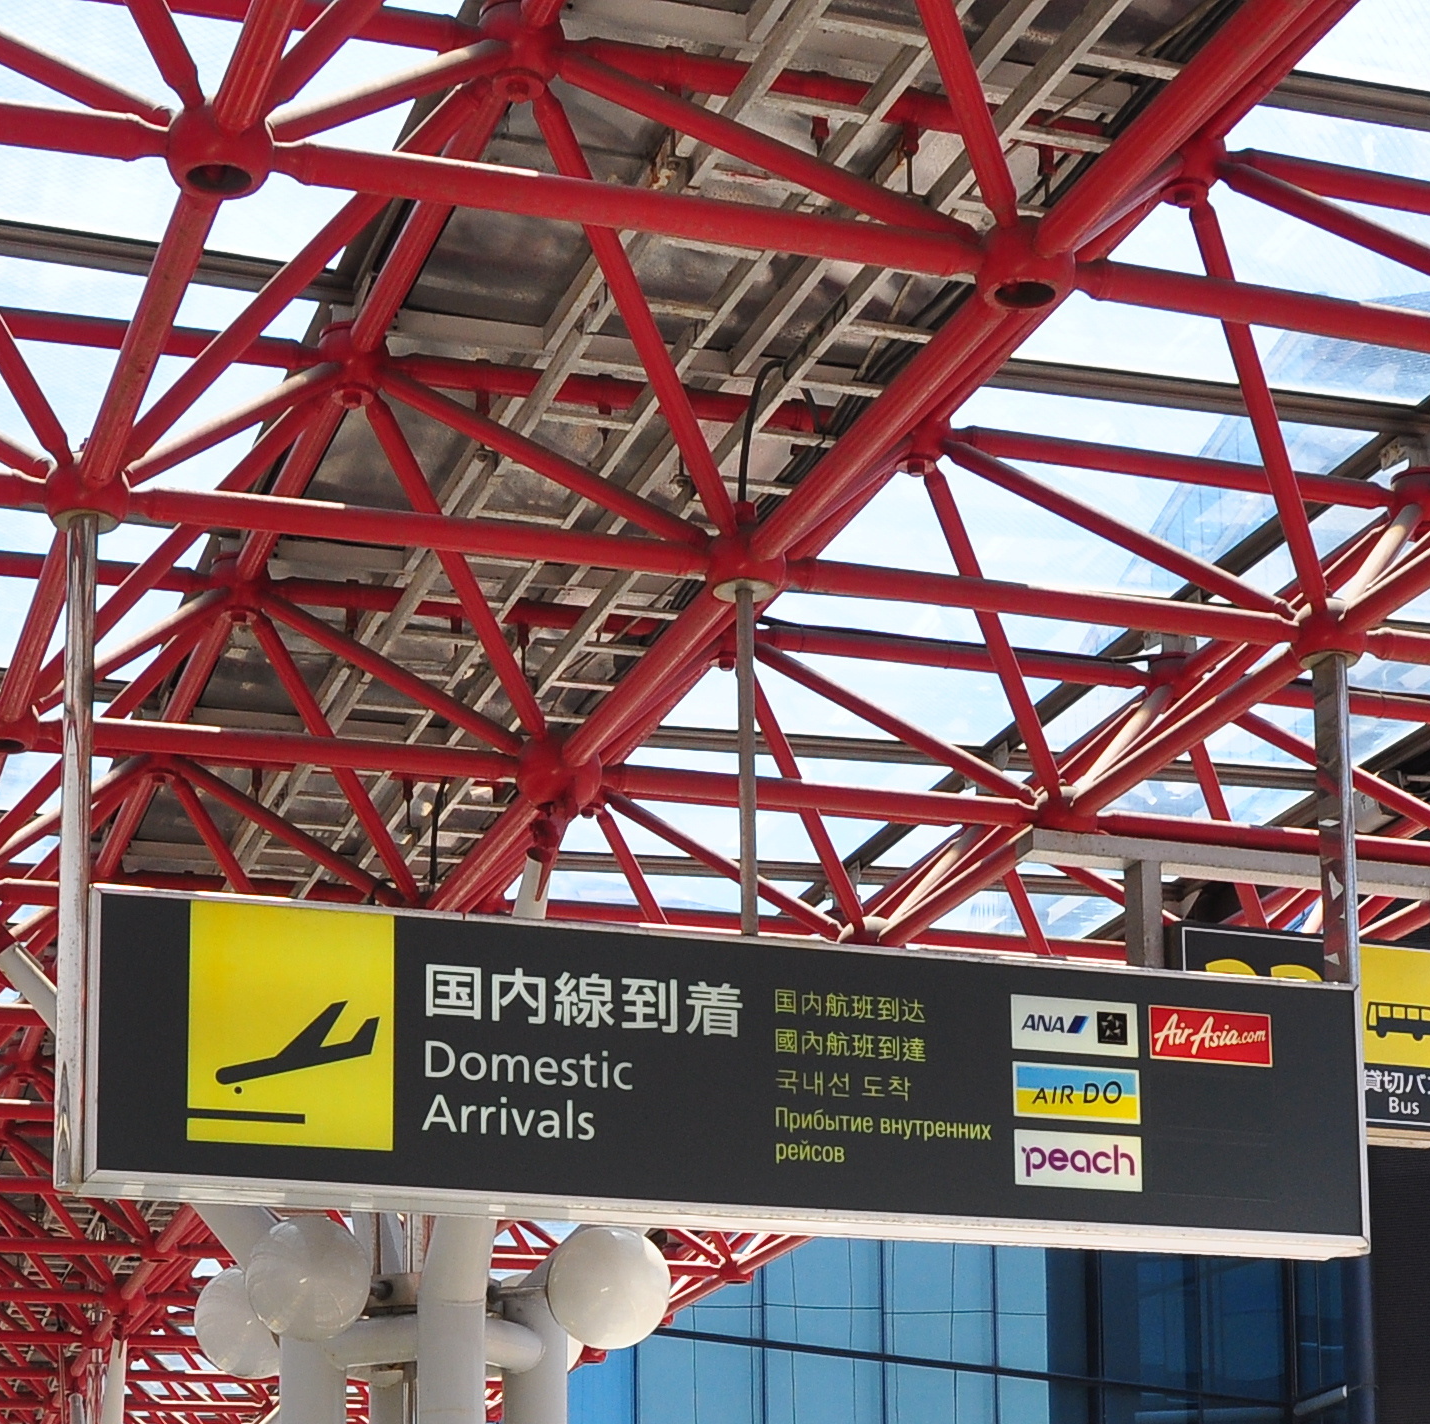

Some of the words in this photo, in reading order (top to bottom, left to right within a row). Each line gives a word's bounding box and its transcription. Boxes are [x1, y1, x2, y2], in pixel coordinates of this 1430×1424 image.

[425, 963, 744, 1038] 国内線到着
[774, 988, 926, 1024] 国内航班到达
[1021, 1013, 1066, 1034] ANA
[424, 1040, 634, 1091] Domestic
[775, 1069, 851, 1098] 국내선
[861, 1075, 912, 1102] 도착
[1031, 1085, 1075, 1105] AIR
[1082, 1080, 1122, 1105] DO
[421, 1094, 596, 1141] Arrivals
[1388, 1097, 1421, 1115] Bus
[775, 1106, 874, 1134] Прибытие
[879, 1116, 993, 1142] внутренних
[775, 1139, 846, 1165] рейсов
[1021, 1144, 1136, 1178] peach
